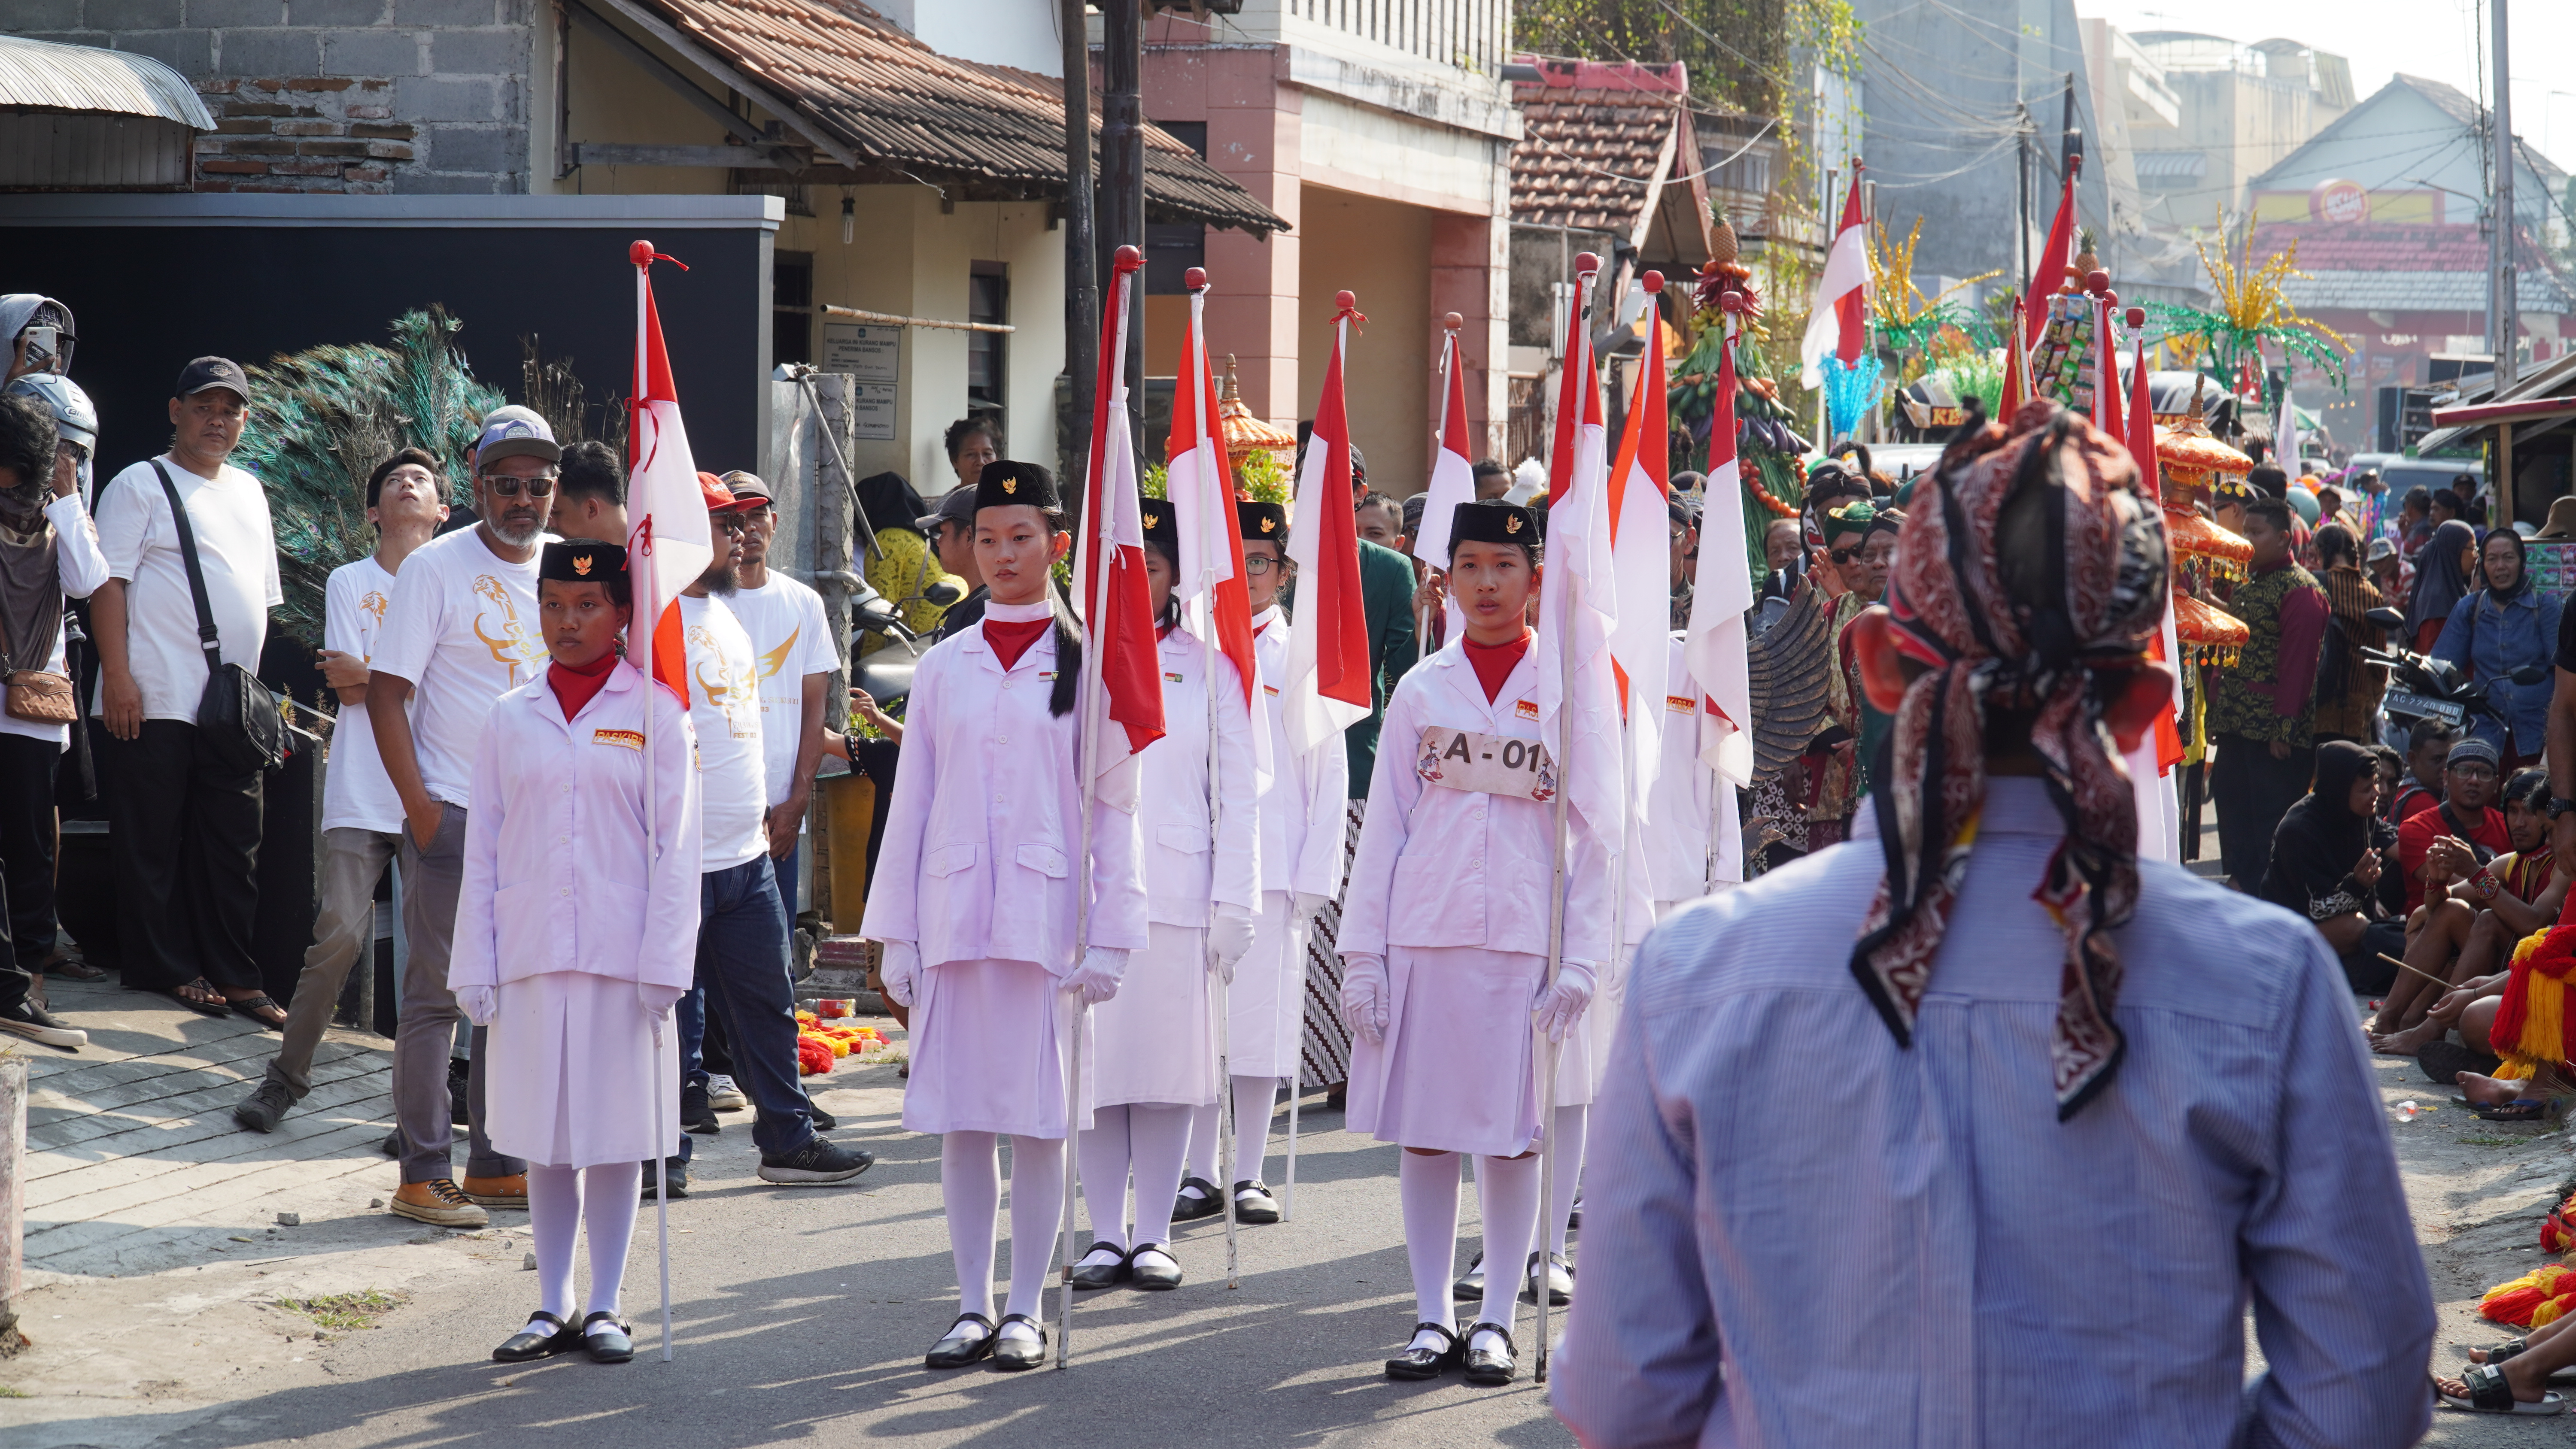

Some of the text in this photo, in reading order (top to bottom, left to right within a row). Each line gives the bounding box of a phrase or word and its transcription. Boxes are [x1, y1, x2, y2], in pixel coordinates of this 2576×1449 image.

[2392, 694, 2406, 703] AG
[1443, 733, 1471, 764] A
[1503, 740, 1541, 772] 01
